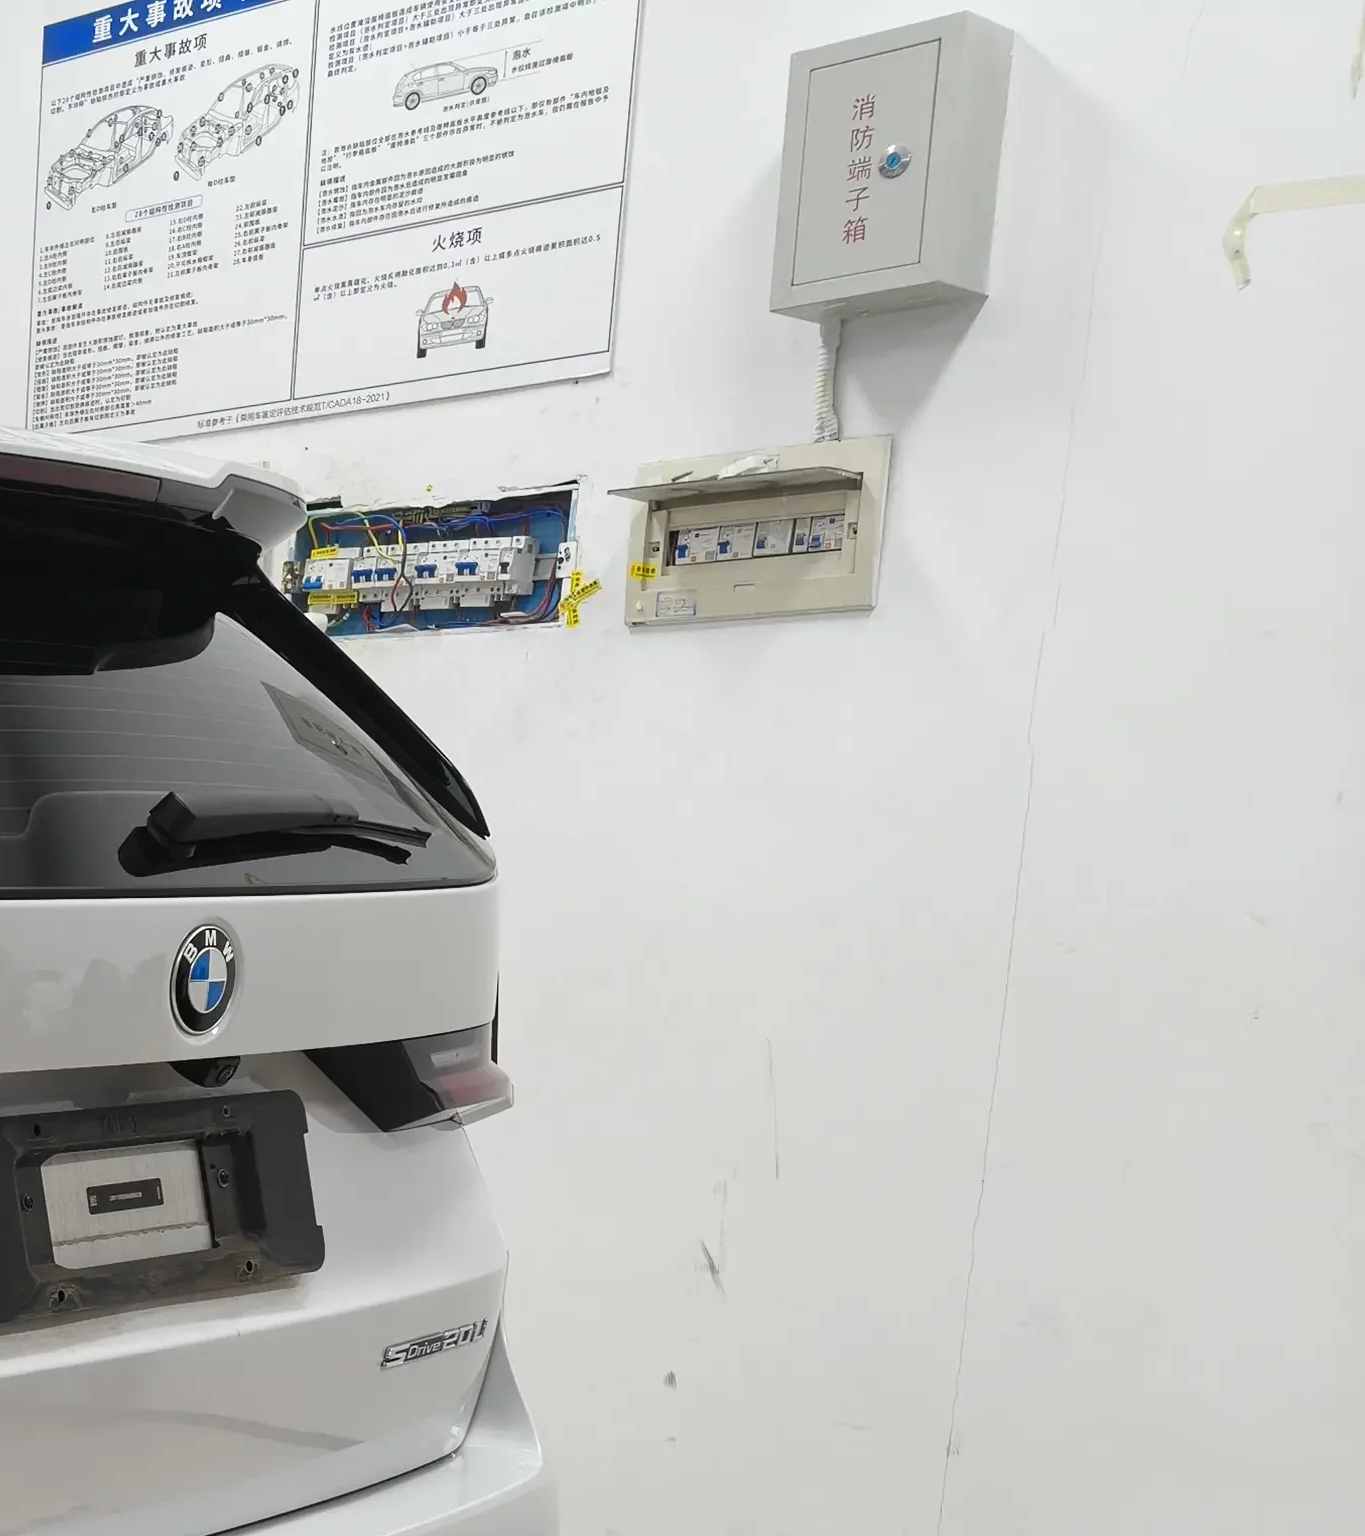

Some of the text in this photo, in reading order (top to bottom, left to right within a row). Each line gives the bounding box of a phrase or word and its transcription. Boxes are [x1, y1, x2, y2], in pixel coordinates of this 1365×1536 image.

[134, 33, 208, 67] 重大事故项
[512, 47, 531, 60] 泡水
[842, 94, 876, 244] 消防端子箱
[431, 227, 483, 252] 火烧项
[183, 929, 234, 964] BMW
